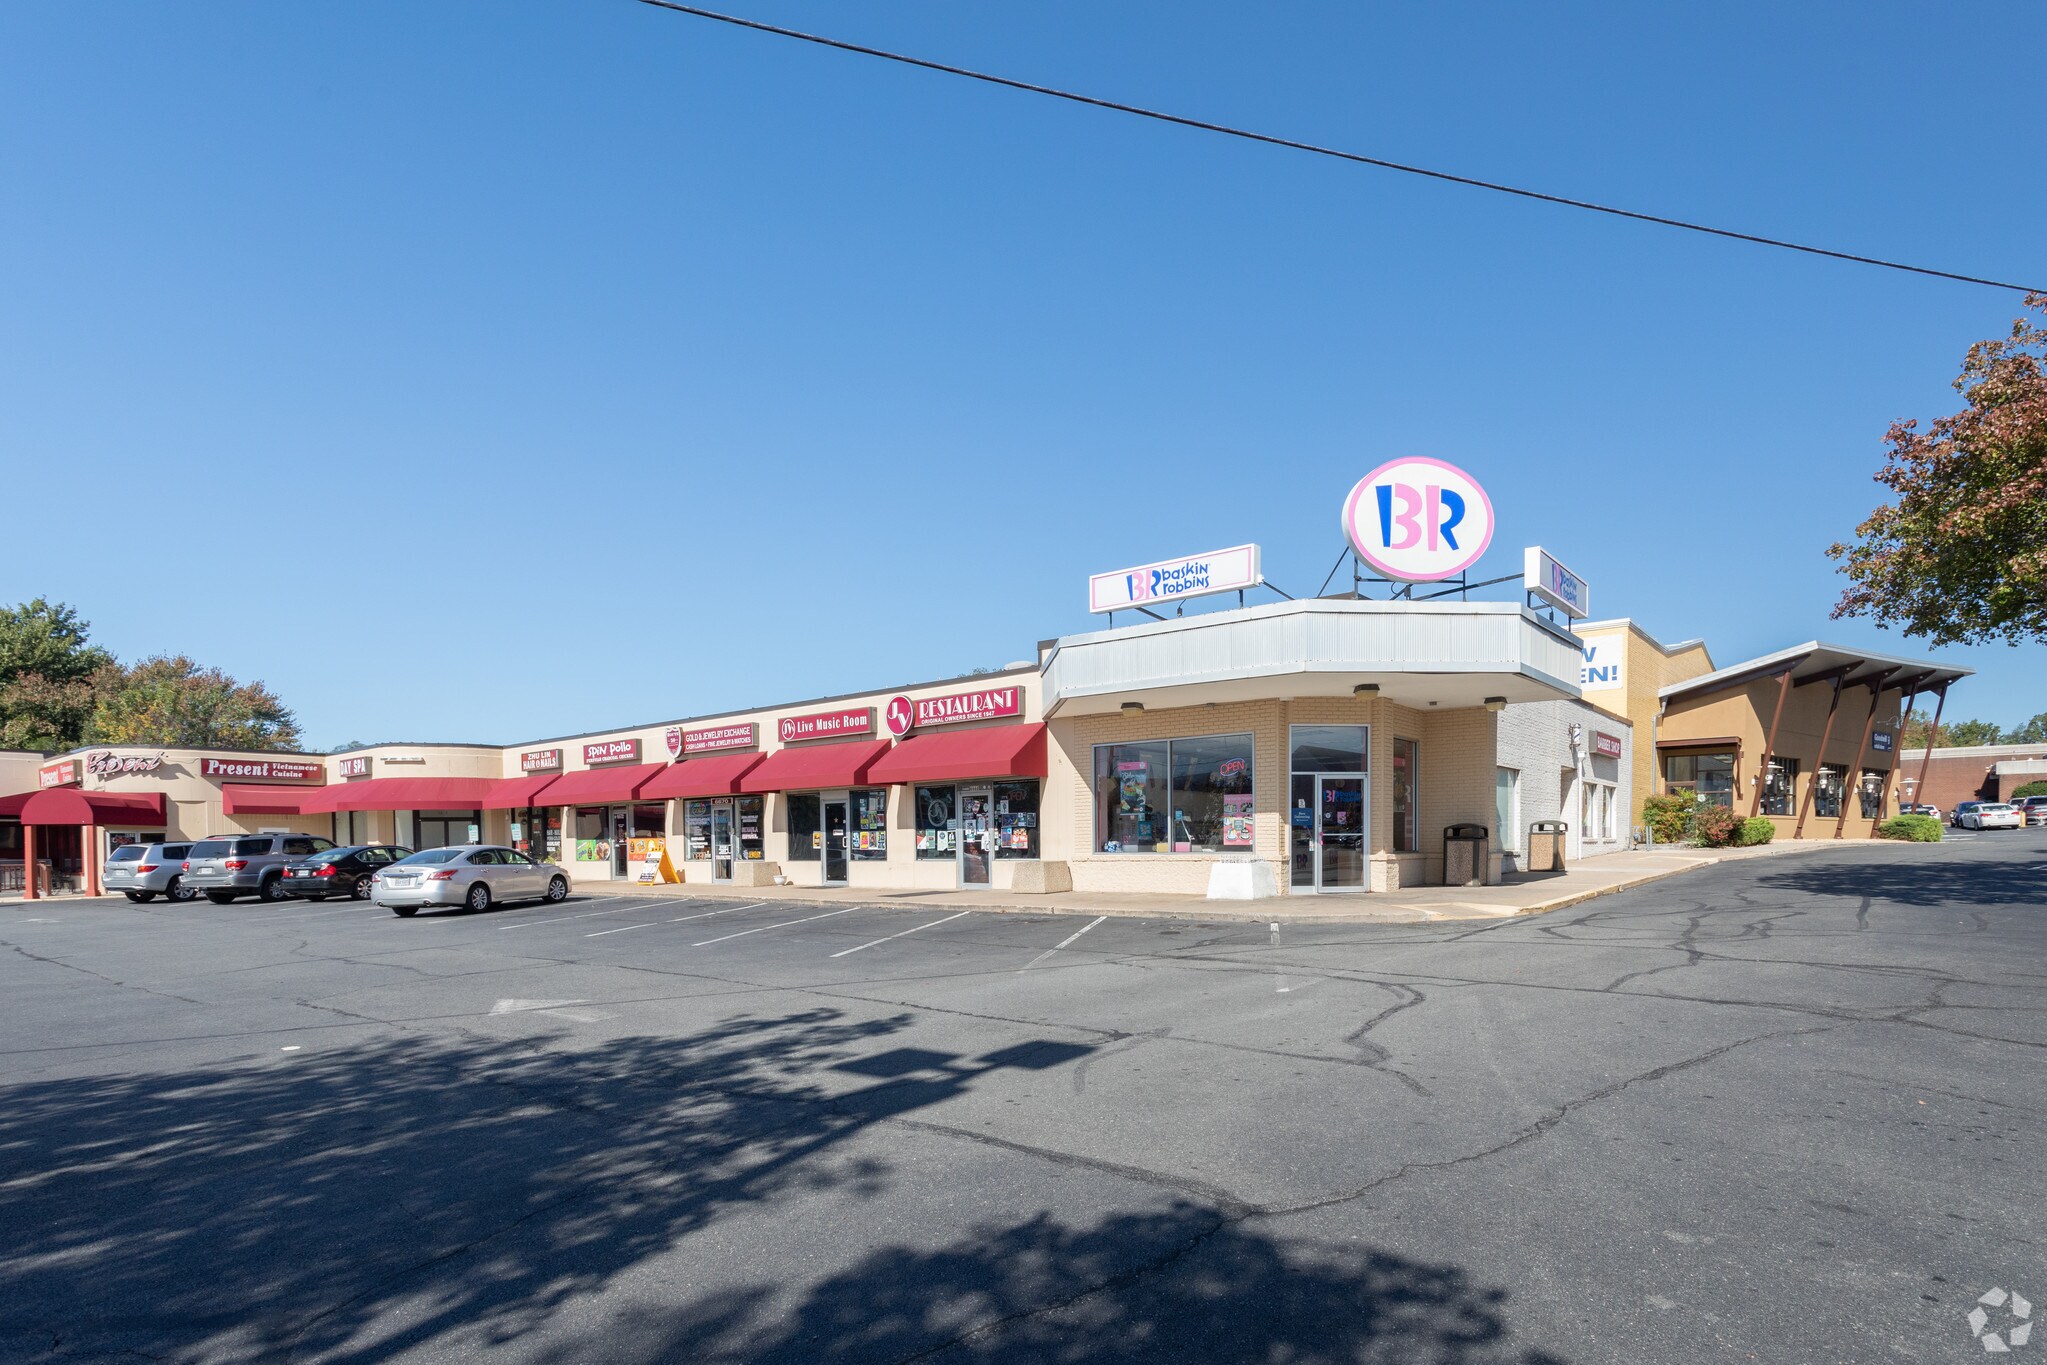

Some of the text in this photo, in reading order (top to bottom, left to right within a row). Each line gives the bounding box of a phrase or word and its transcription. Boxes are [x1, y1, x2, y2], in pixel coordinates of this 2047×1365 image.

[1376, 483, 1465, 552] BR
[1162, 562, 1209, 581] baskin
[1126, 569, 1161, 600] BR
[1162, 575, 1209, 595] robbins
[919, 689, 1014, 719] RESTAURANT
[797, 721, 813, 733] Live
[816, 717, 840, 731] Music
[843, 715, 867, 728] Room
[887, 701, 910, 731] JV
[921, 717, 944, 725] ORIGINAL
[944, 714, 966, 722] OWNERS
[967, 712, 982, 720] SINCE
[685, 733, 698, 742] GOLD
[702, 729, 723, 740] JEWELRY
[724, 726, 751, 738] EXCHANGE
[523, 759, 536, 770] HAIR
[540, 757, 556, 768] NAILS
[527, 750, 551, 760] ZHU LIN
[206, 759, 269, 777] Present
[272, 762, 318, 772] Vietnamese
[272, 770, 303, 778] Cuisine
[340, 758, 367, 775] DAY SPA
[1220, 760, 1245, 774] OPEN
